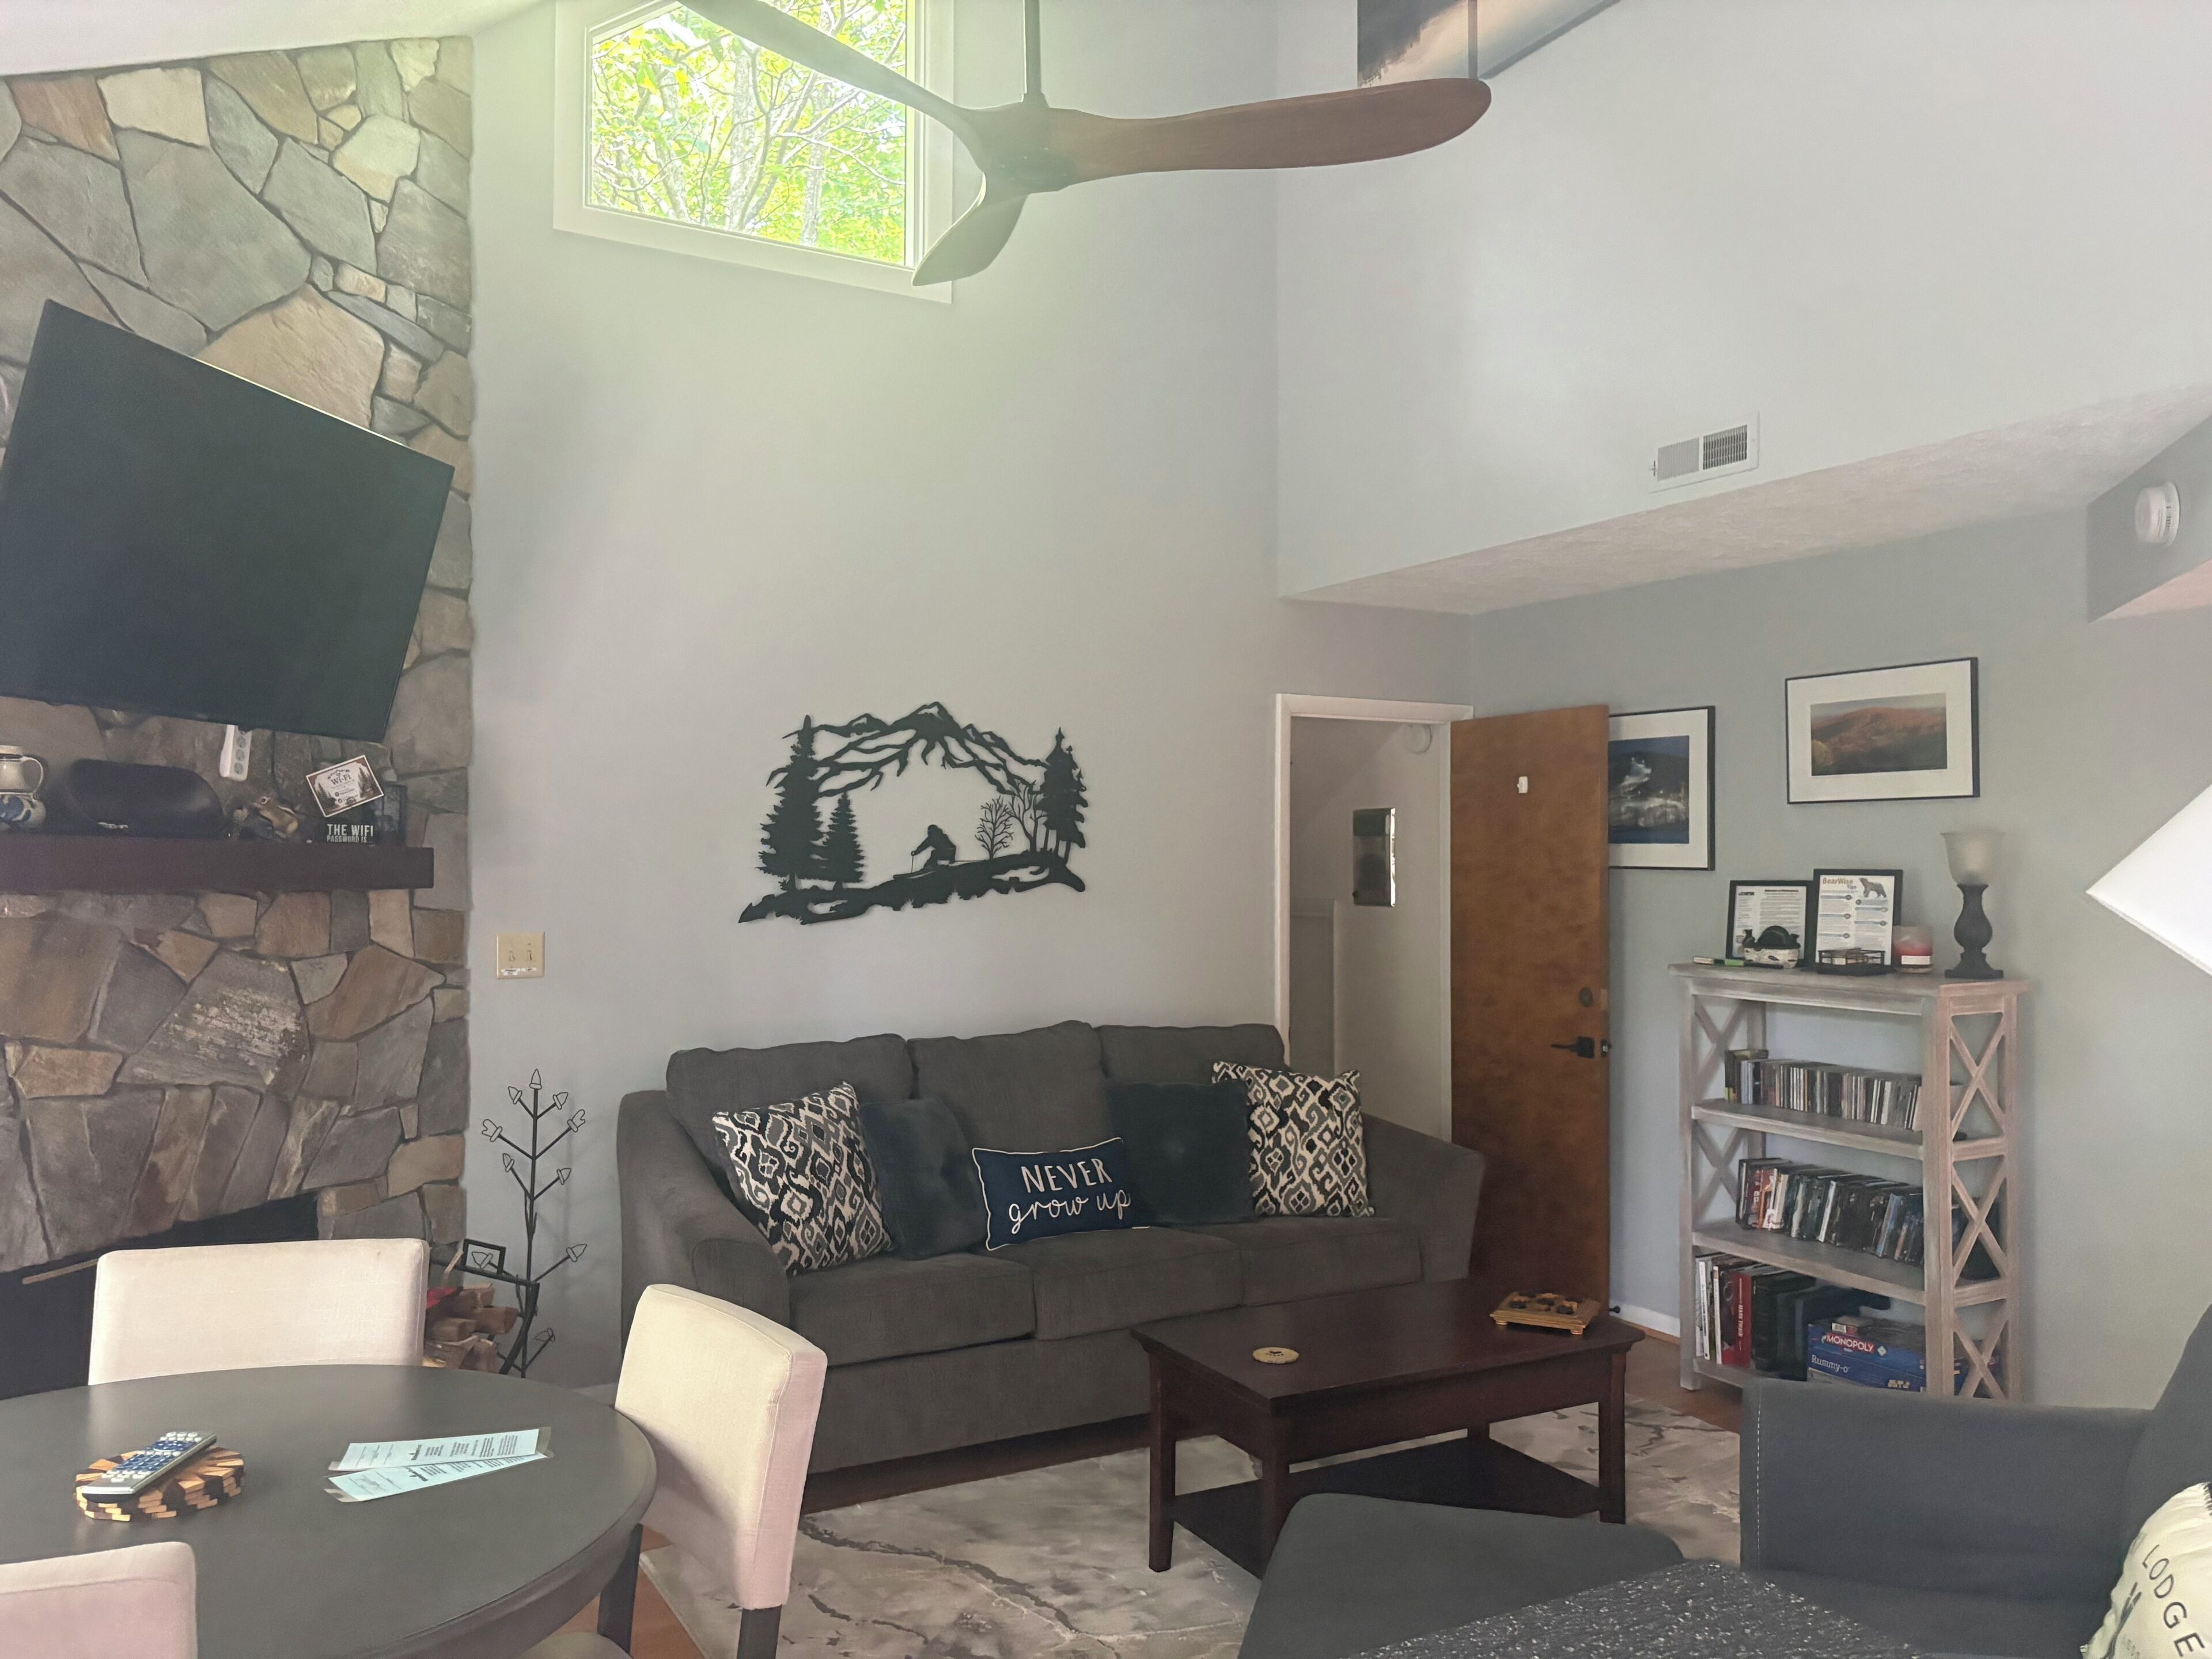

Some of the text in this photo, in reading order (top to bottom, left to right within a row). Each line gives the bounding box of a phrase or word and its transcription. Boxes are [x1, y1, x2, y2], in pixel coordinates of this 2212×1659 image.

[327, 824, 373, 837] THE WIFI
[327, 835, 359, 843] PASSWORD
[1021, 1158, 1113, 1194] NEVER
[1009, 1189, 1131, 1234] grow up
[1825, 1335, 1875, 1353] MONOPOLY
[2142, 1544, 2205, 1657] LODGE
